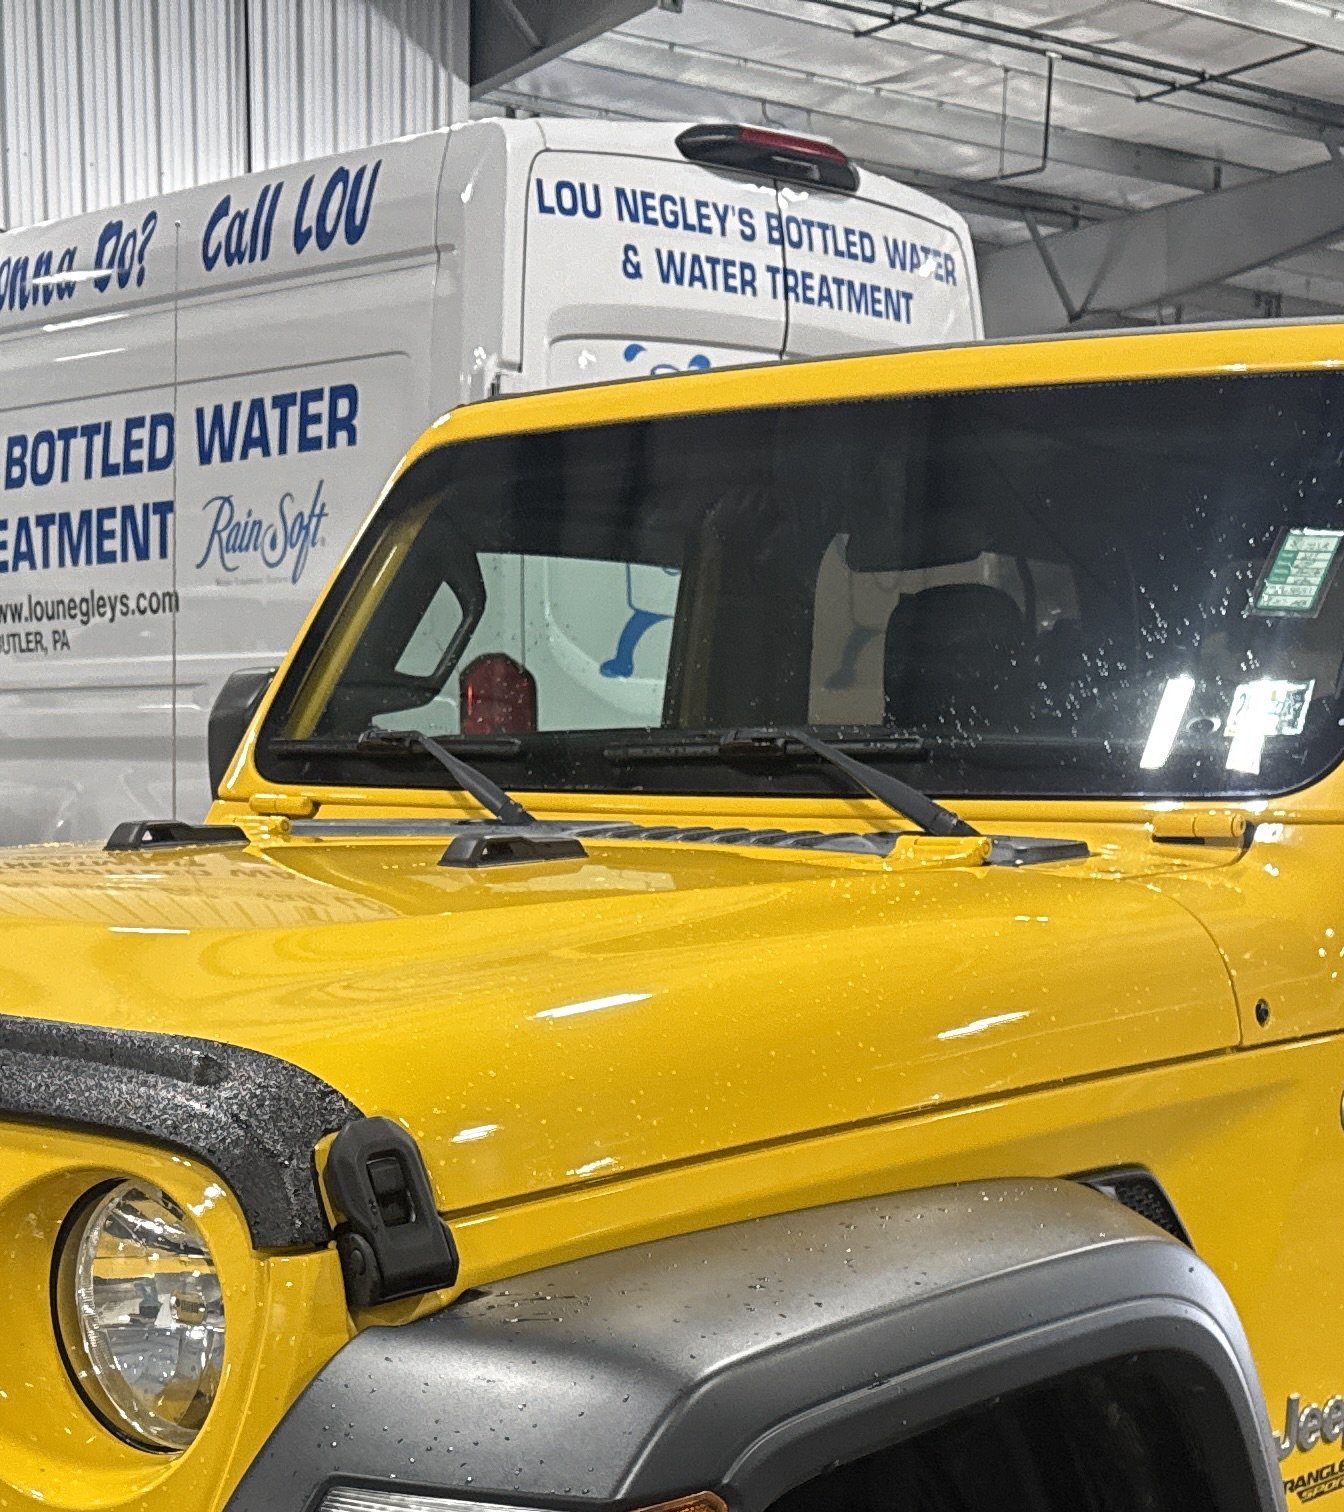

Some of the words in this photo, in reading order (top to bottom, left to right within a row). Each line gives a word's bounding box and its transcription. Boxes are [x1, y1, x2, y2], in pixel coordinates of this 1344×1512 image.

[94, 210, 157, 293] Do?
[202, 181, 284, 272] Call
[293, 158, 382, 255] LOU
[536, 178, 602, 219] LOU
[613, 187, 756, 242] NEGLEY'S
[765, 211, 875, 263] BOTTLED
[883, 235, 958, 287] WATER
[622, 243, 642, 280] &
[655, 247, 757, 298] WATER
[766, 265, 913, 325] TREATMENT
[4, 412, 175, 490] BOTTLED
[195, 384, 359, 467] WATER
[52, 629, 71, 652] PA
